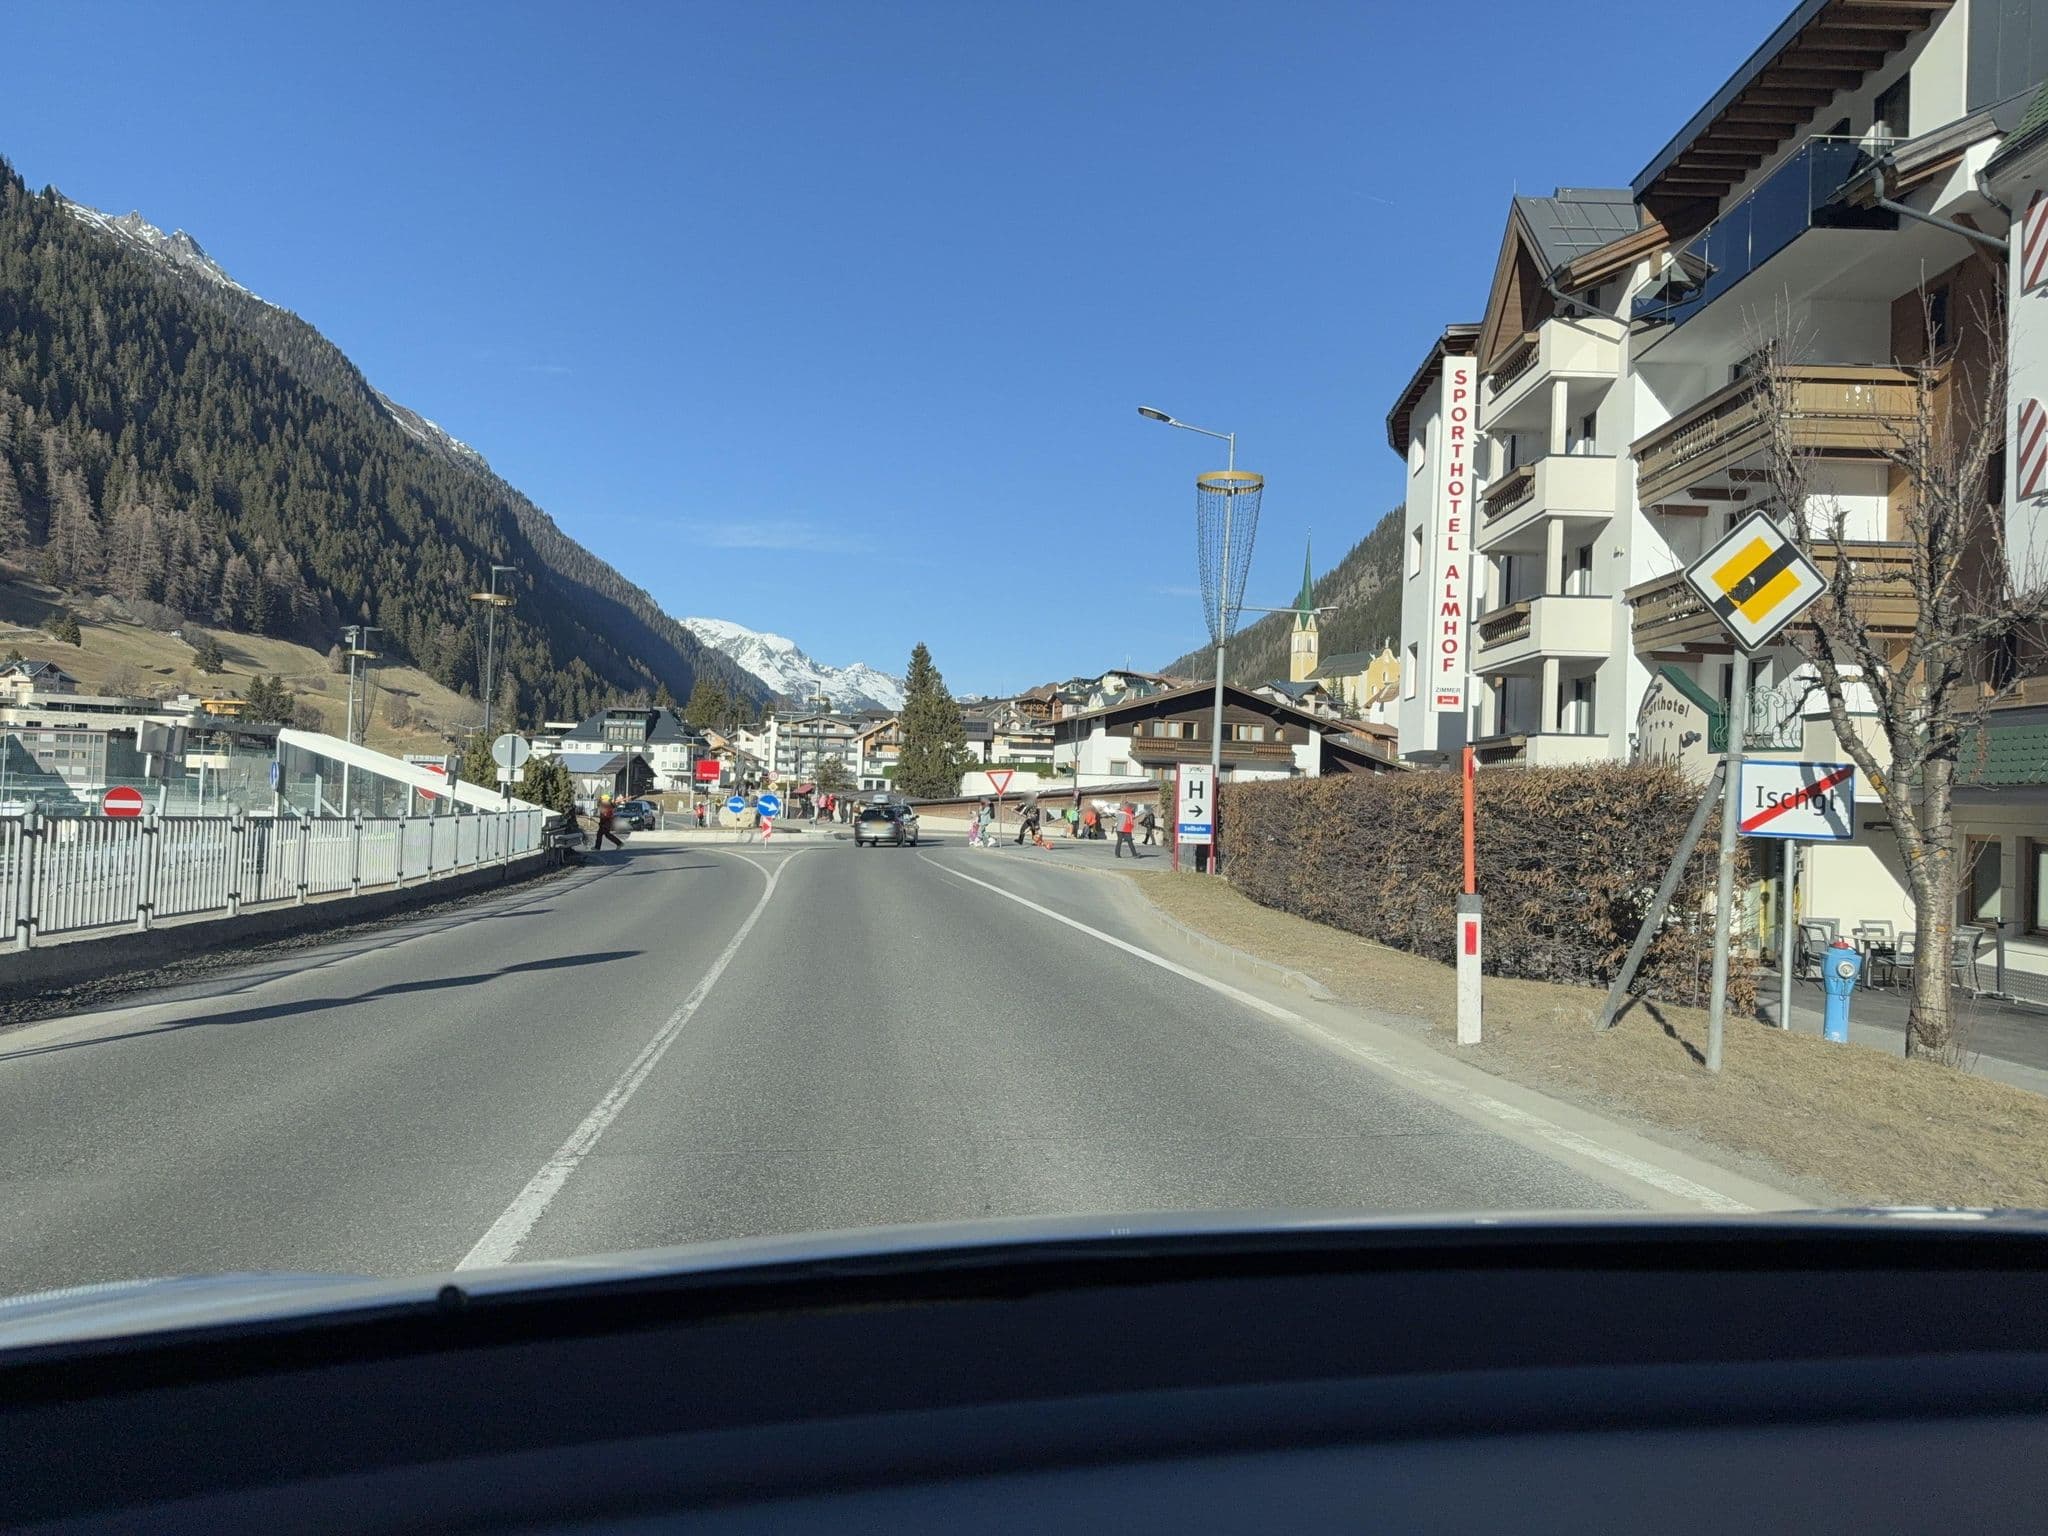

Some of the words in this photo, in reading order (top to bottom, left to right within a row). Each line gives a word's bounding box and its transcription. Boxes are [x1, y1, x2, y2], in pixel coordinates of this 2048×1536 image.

[1448, 370, 1467, 551] SPORTHOTEL
[1440, 565, 1461, 673] ALMHOF
[1641, 696, 1690, 728] Sorthotel
[1189, 781, 1203, 799] H
[1755, 785, 1836, 816] Ischgl
